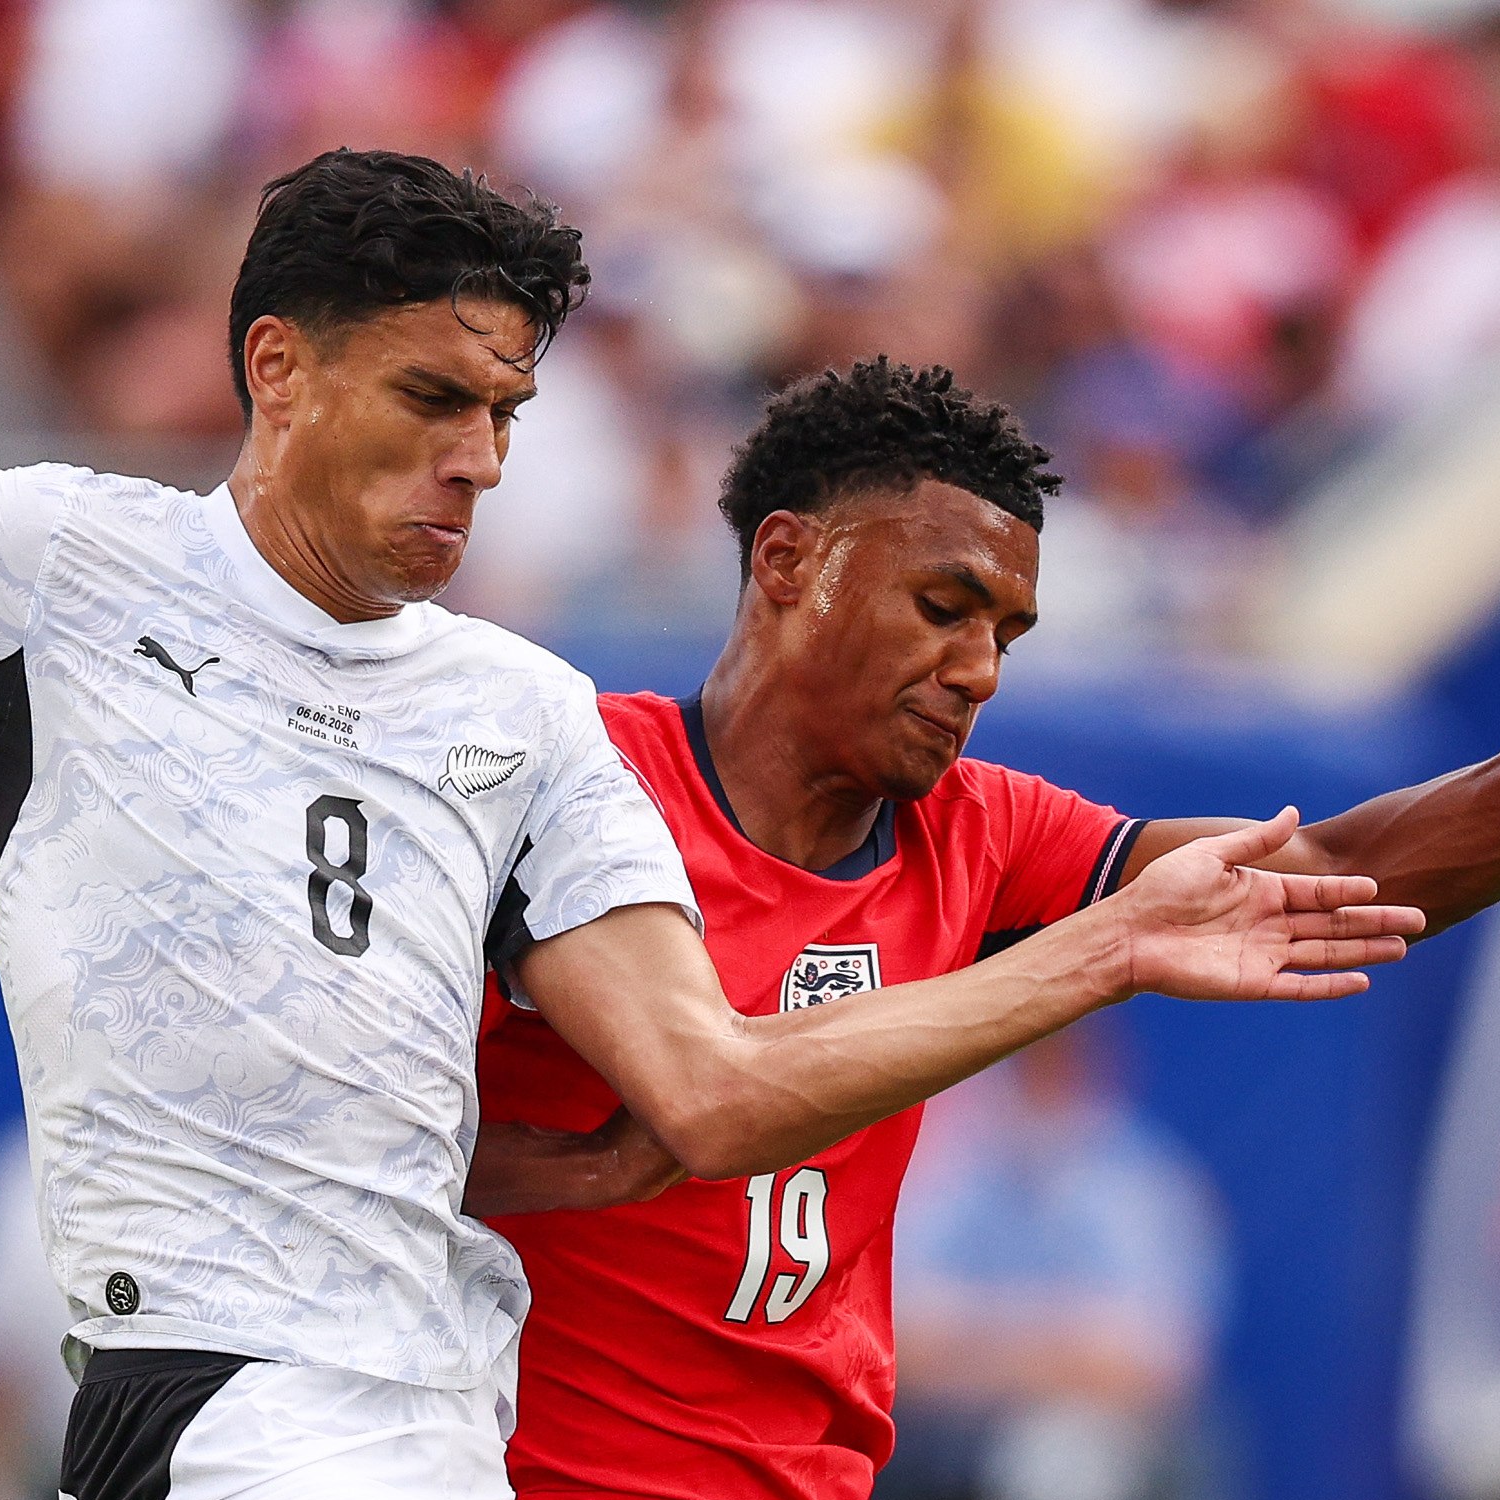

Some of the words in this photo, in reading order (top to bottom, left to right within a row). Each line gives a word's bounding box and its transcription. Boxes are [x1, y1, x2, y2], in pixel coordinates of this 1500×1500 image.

[296, 706, 353, 735] 06.06.2026
[338, 705, 361, 721] ENG
[333, 734, 359, 751] USA
[306, 794, 373, 957] 8
[723, 1165, 831, 1324] 19
